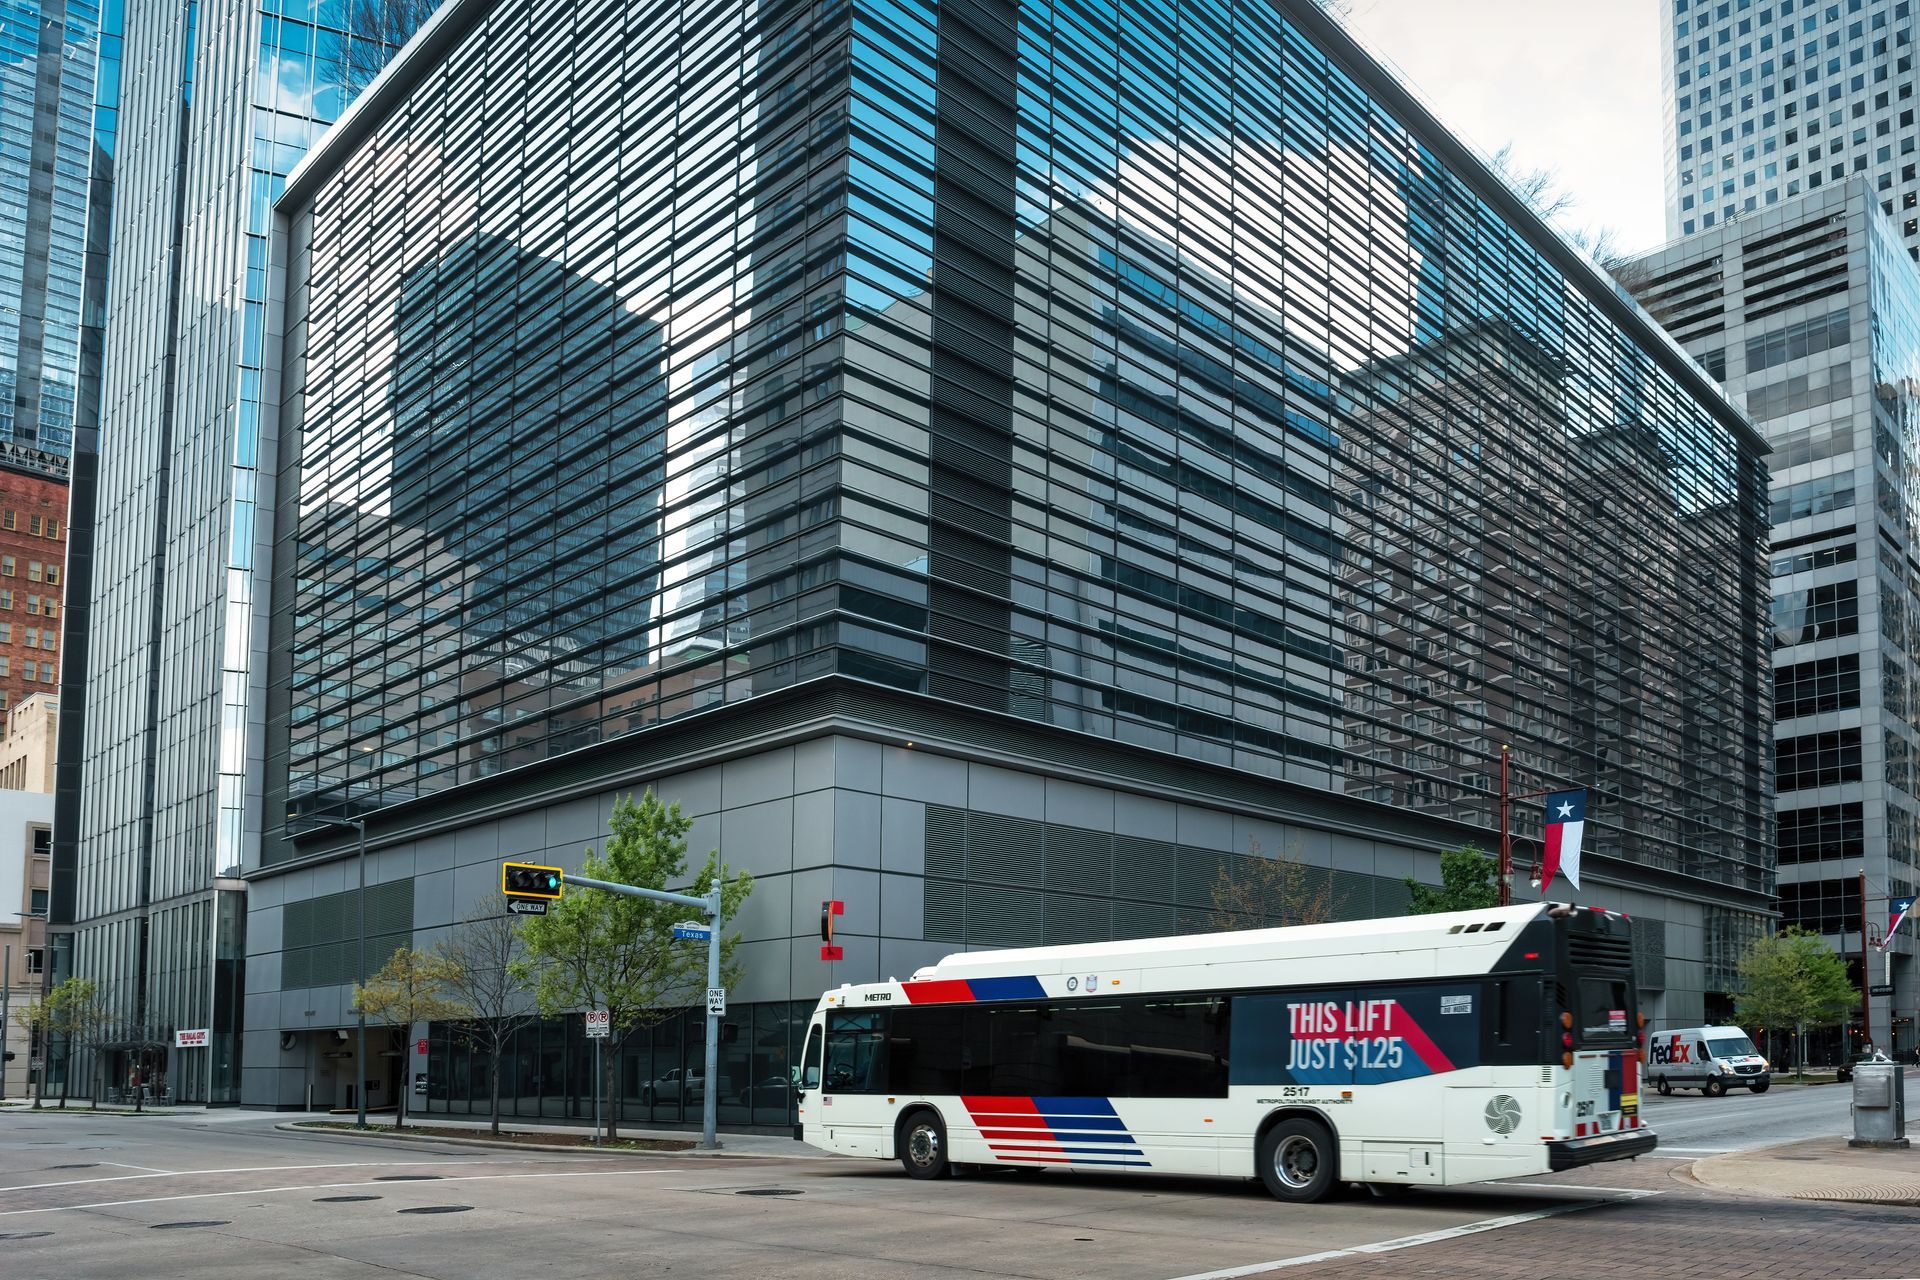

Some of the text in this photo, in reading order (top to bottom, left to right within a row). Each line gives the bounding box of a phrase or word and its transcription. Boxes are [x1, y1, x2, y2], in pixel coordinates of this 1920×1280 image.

[682, 930, 704, 939] Texas
[709, 997, 723, 1005] WAY
[864, 993, 892, 1001] METRO
[1286, 999, 1396, 1034] THIS LIFT
[1285, 1036, 1403, 1070] JUST $1.25
[1649, 1034, 1690, 1064] FedEx
[1283, 1087, 1310, 1096] 2517
[1576, 1100, 1594, 1117] 2517
